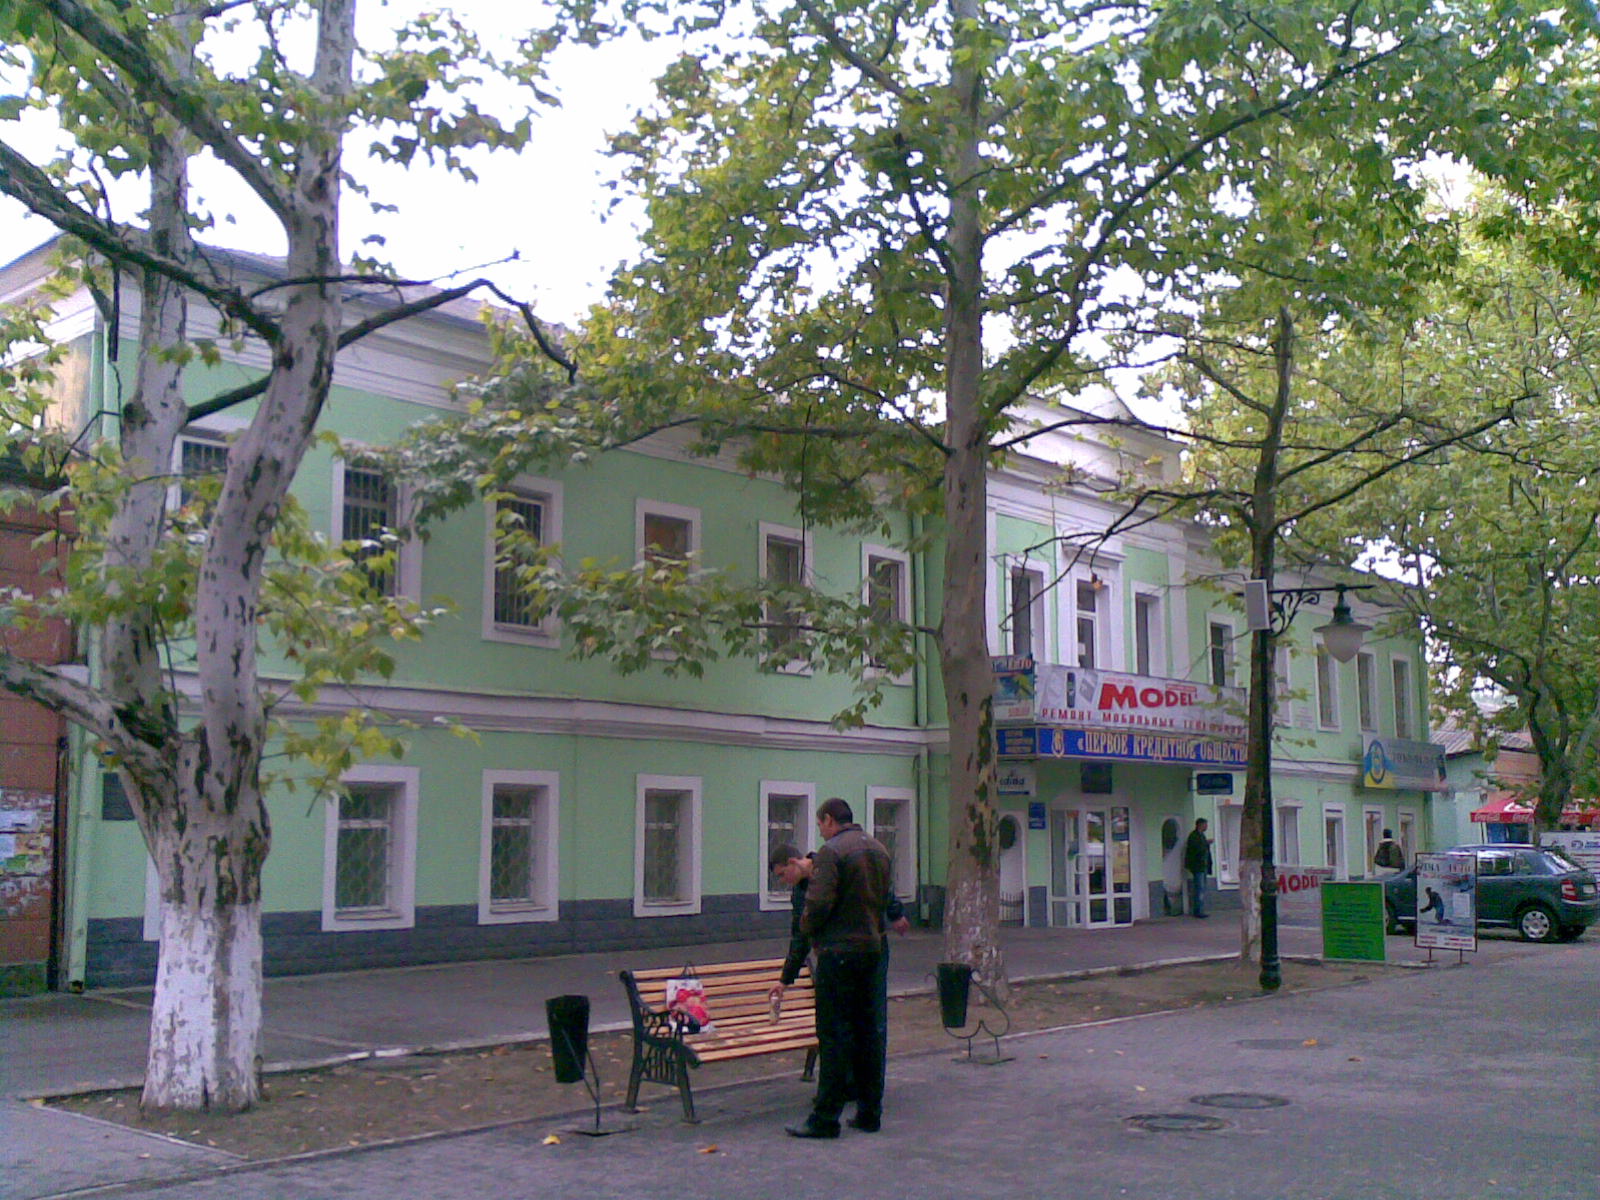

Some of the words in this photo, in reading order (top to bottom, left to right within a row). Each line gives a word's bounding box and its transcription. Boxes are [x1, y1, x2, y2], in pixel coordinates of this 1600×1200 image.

[1098, 683, 1194, 710] MODEL
[1042, 708, 1091, 721] РЕМОНТ
[1102, 712, 1174, 728] МОБИЛЬНЫХ
[1133, 734, 1196, 761] КРЕДИТНОЕ
